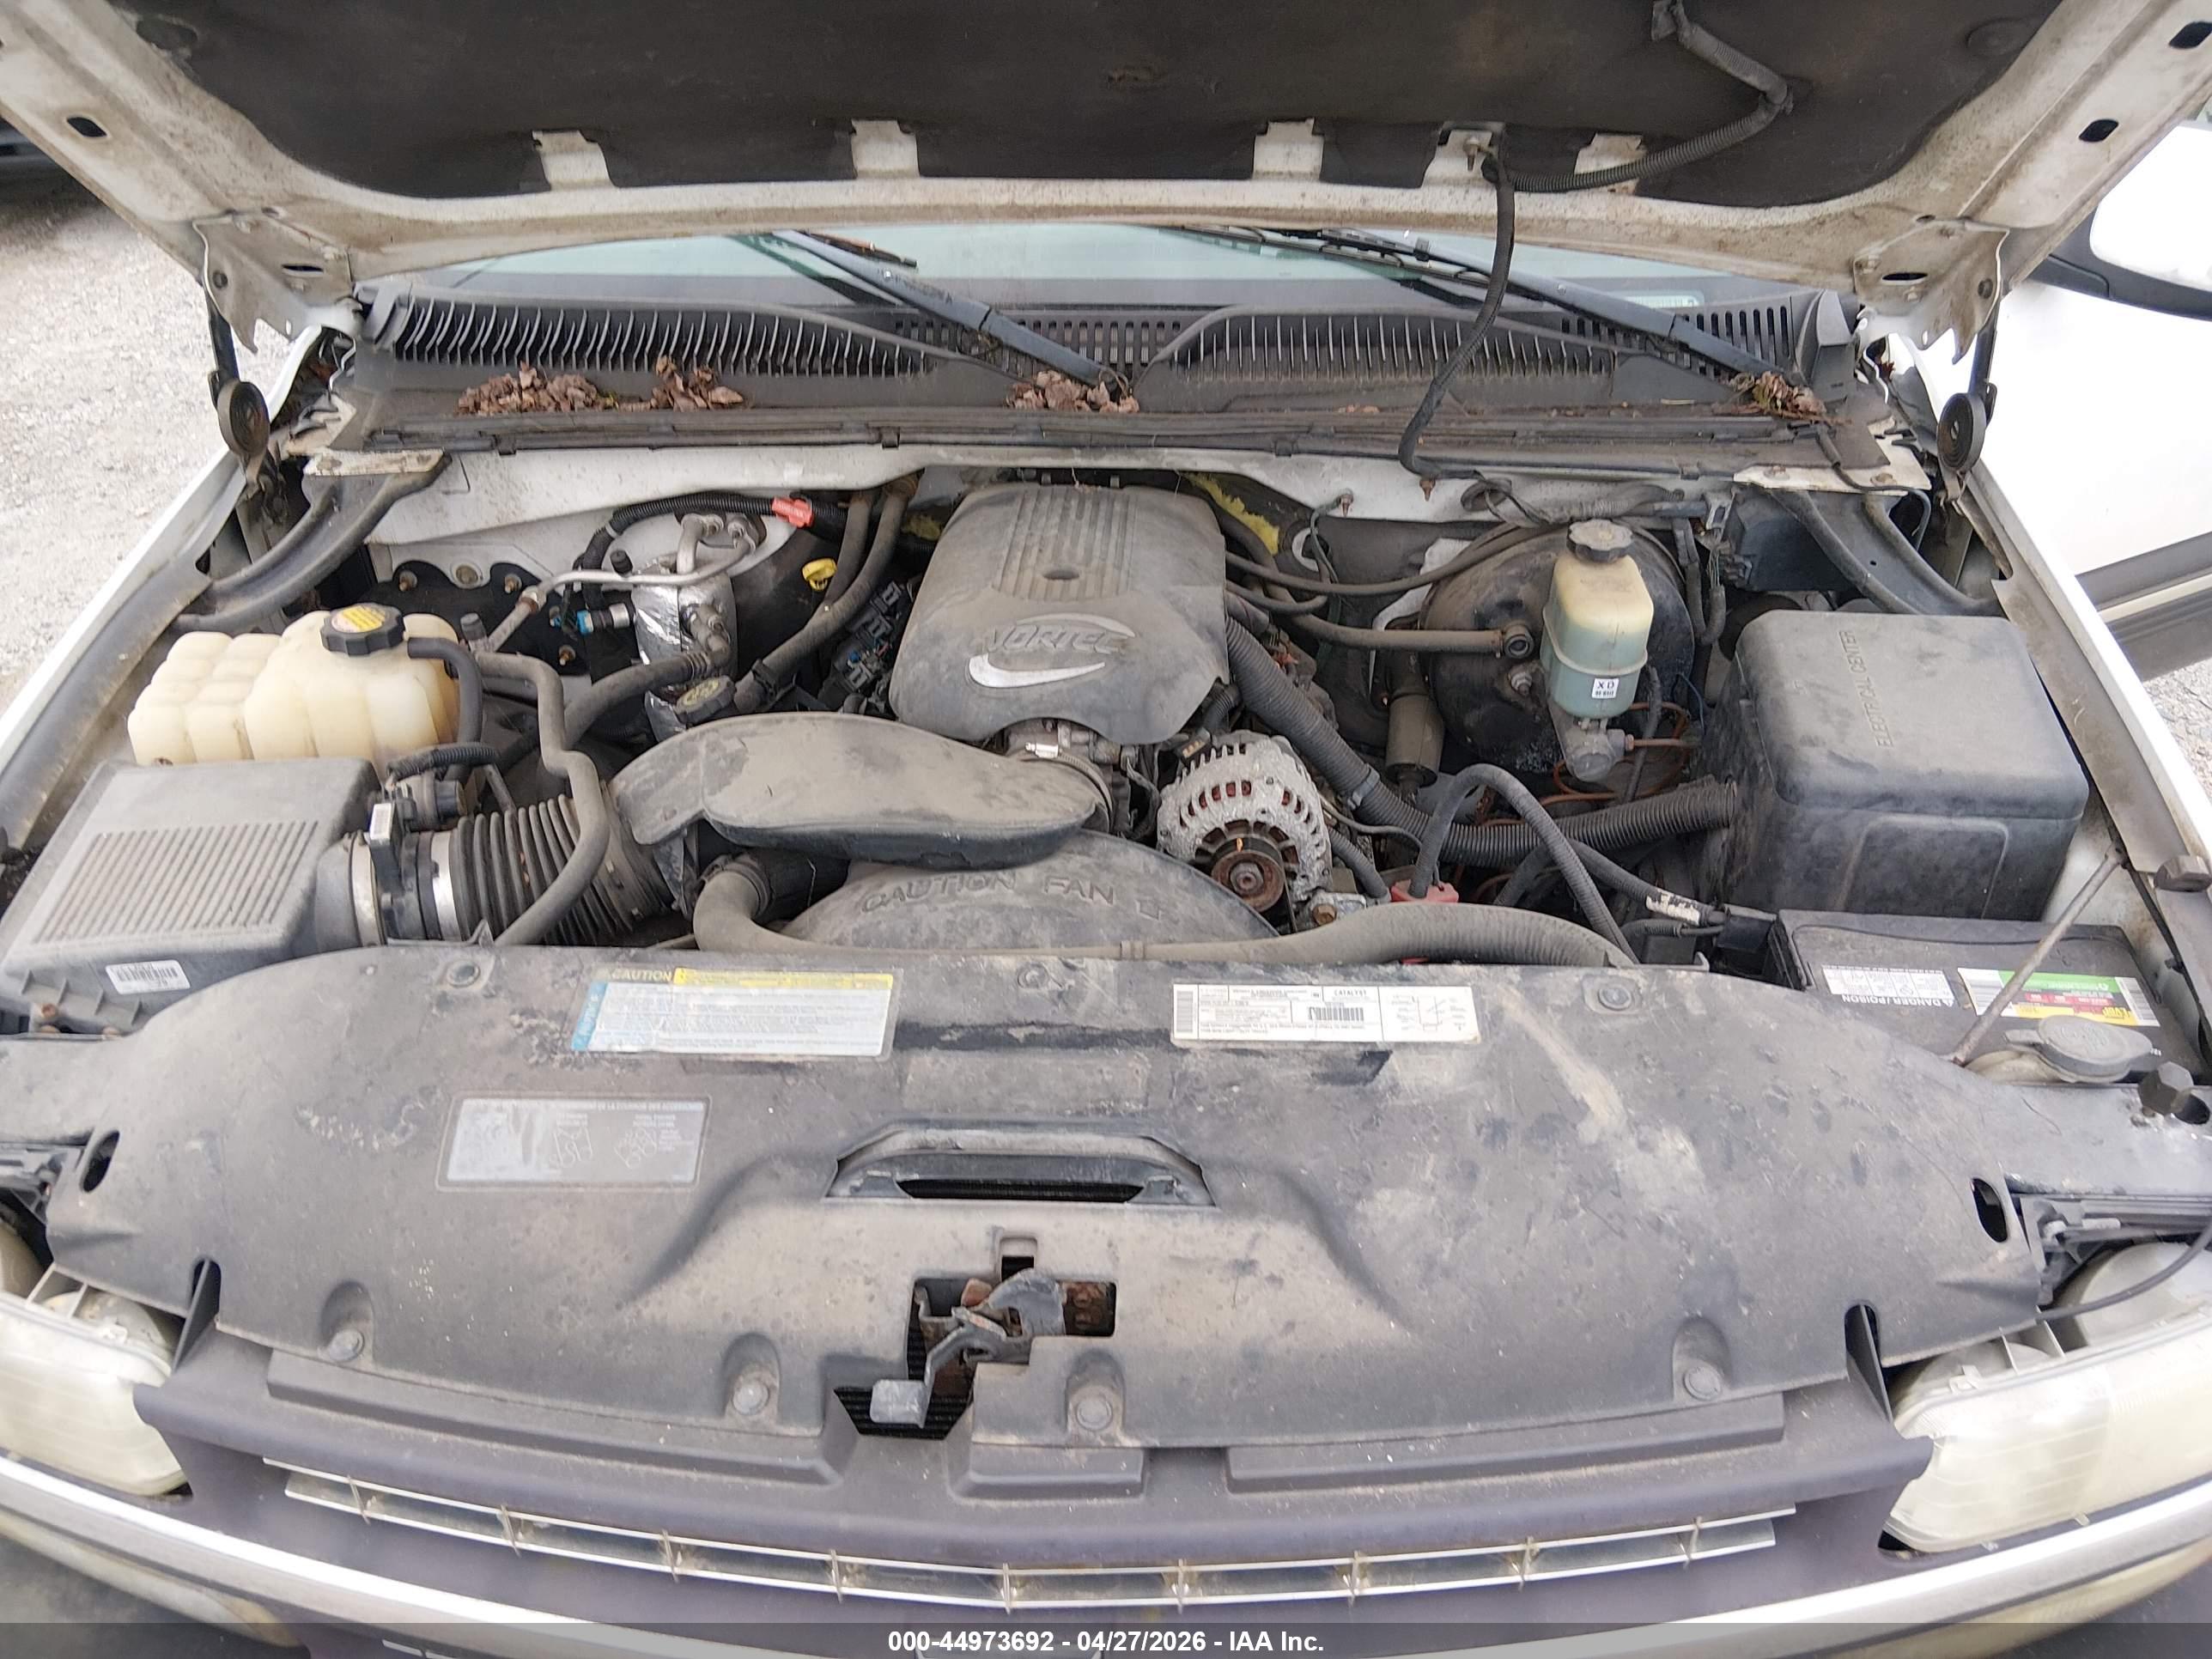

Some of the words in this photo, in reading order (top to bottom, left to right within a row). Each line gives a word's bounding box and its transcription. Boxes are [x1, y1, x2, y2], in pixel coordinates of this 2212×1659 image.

[988, 624, 1120, 654] VORTEC
[1837, 630, 1868, 673] CENTER
[861, 872, 1017, 912] CAUTION
[1044, 875, 1115, 906] FAN
[611, 968, 673, 981] CAUTION
[1334, 988, 1367, 997] CATALYST
